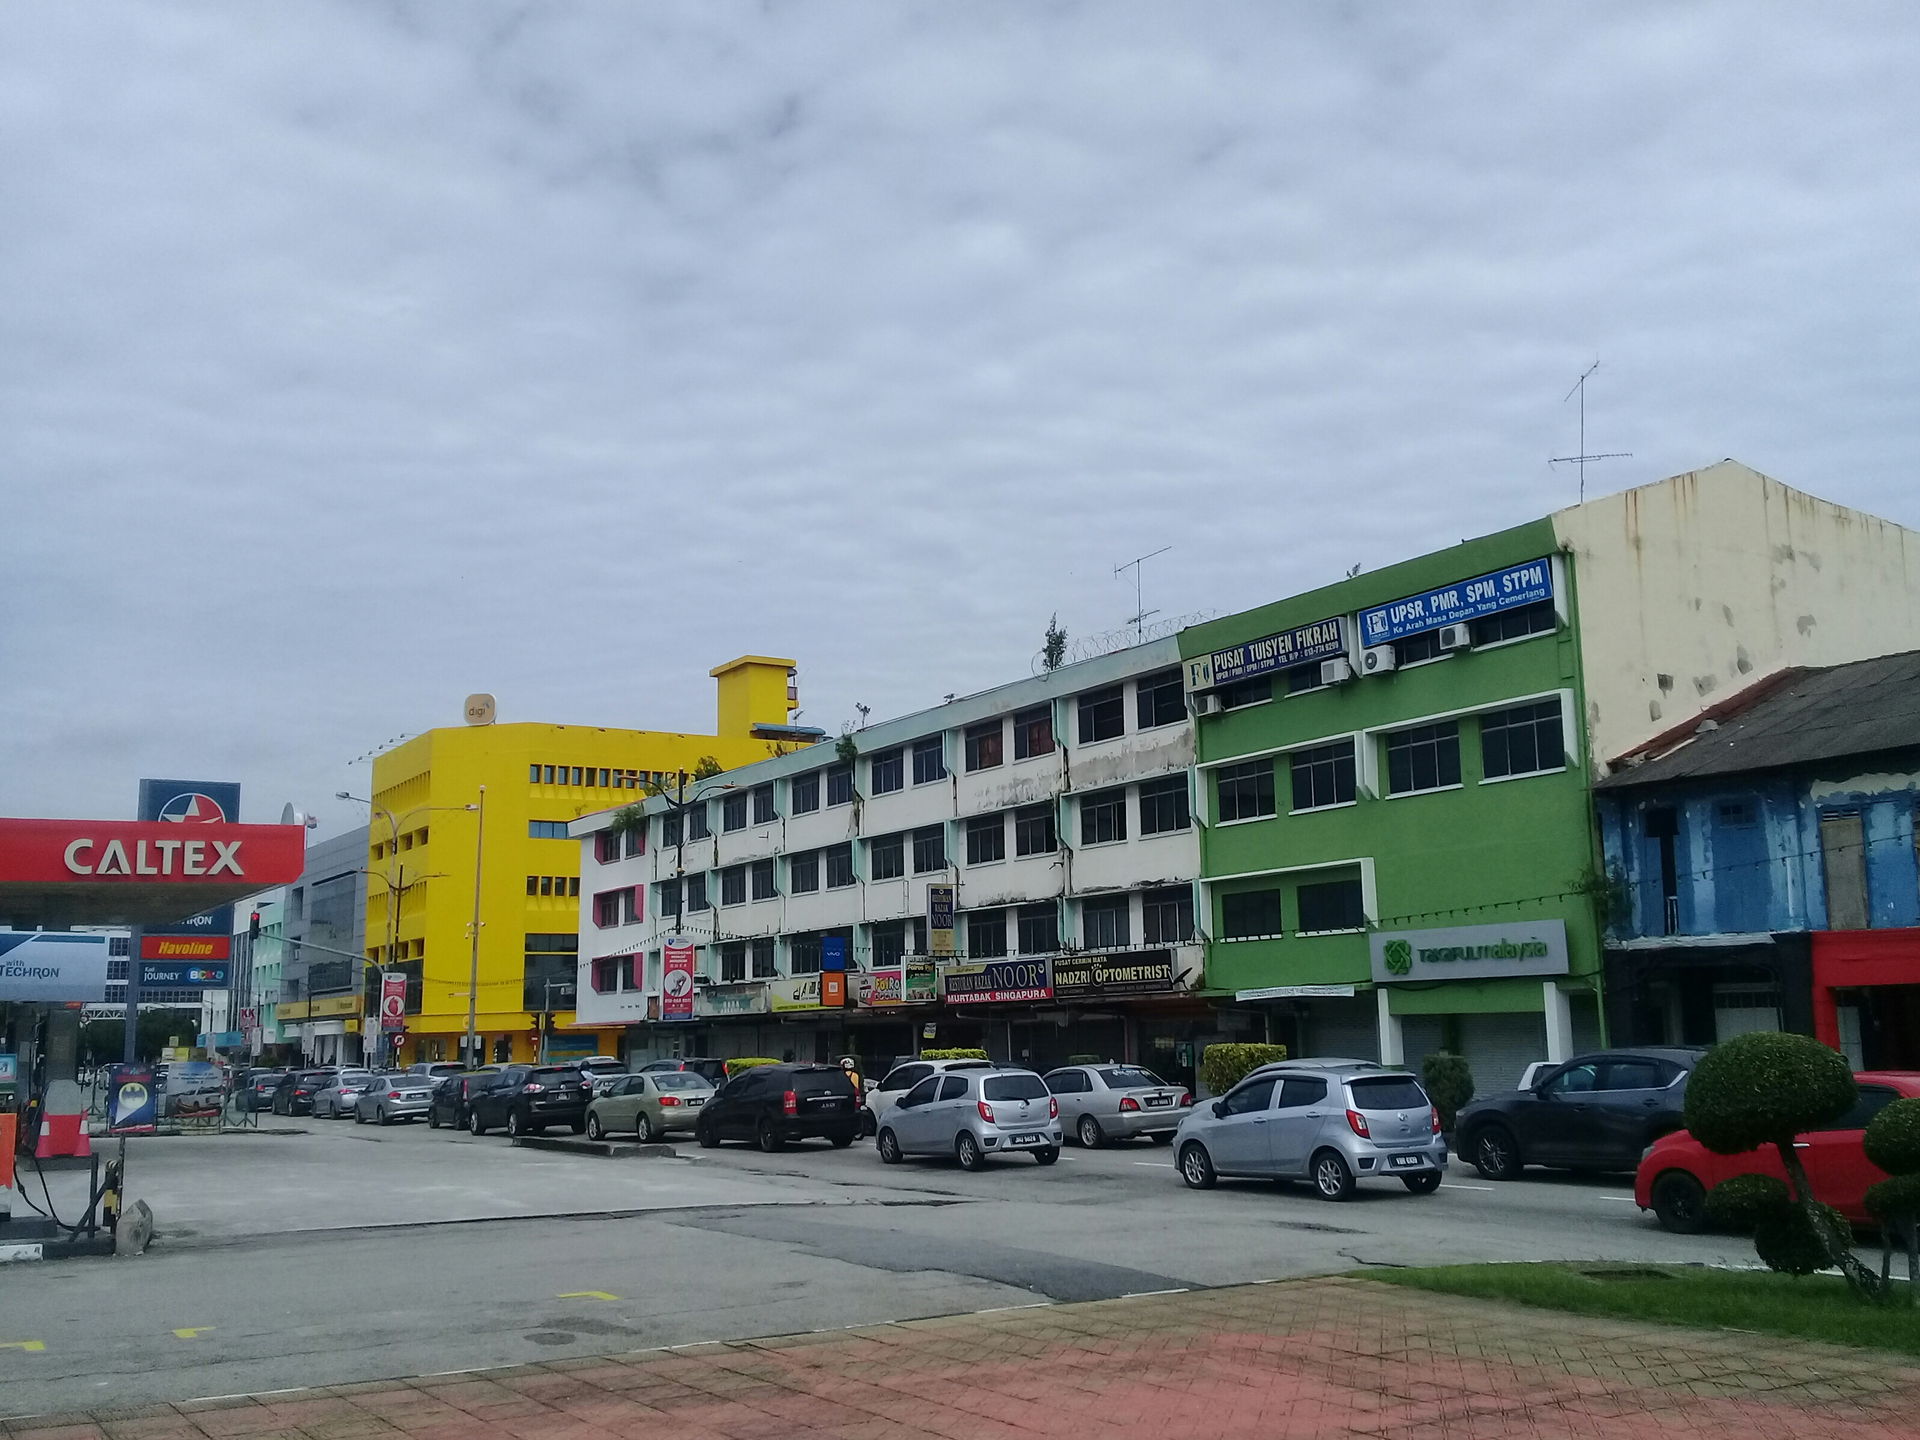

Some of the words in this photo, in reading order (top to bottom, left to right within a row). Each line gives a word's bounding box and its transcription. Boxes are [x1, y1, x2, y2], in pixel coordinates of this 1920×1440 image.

[1390, 603, 1429, 624] UPSR,
[1430, 590, 1464, 613] PMR,
[1466, 579, 1500, 603] SPM,
[1502, 565, 1543, 593] STPM
[1393, 625, 1403, 634] Ke
[1405, 620, 1424, 632] Arah
[1426, 614, 1447, 626] Masa
[1448, 607, 1474, 621] Depan
[1476, 601, 1497, 613] Yang
[1498, 587, 1545, 605] Cemerlang
[1213, 647, 1245, 672] PUSAT
[1248, 634, 1293, 661] TUISYEN
[1295, 621, 1338, 649] FIKRAH
[64, 839, 244, 875] CALTEX
[931, 914, 952, 927] NOOR
[158, 941, 213, 954] Havoline
[1054, 958, 1071, 967] PUSAT
[1071, 957, 1092, 965] CERMIN
[1092, 955, 1107, 963] MATA
[0, 964, 60, 979] TECHRON
[144, 973, 179, 981] JOURNEY
[992, 963, 1039, 989] NOOR
[1055, 970, 1090, 985] NADZRI
[1095, 964, 1168, 983] OPTOMETRIST
[947, 992, 991, 1003] MURTABAK
[995, 989, 1047, 1000] SINGAPURA
